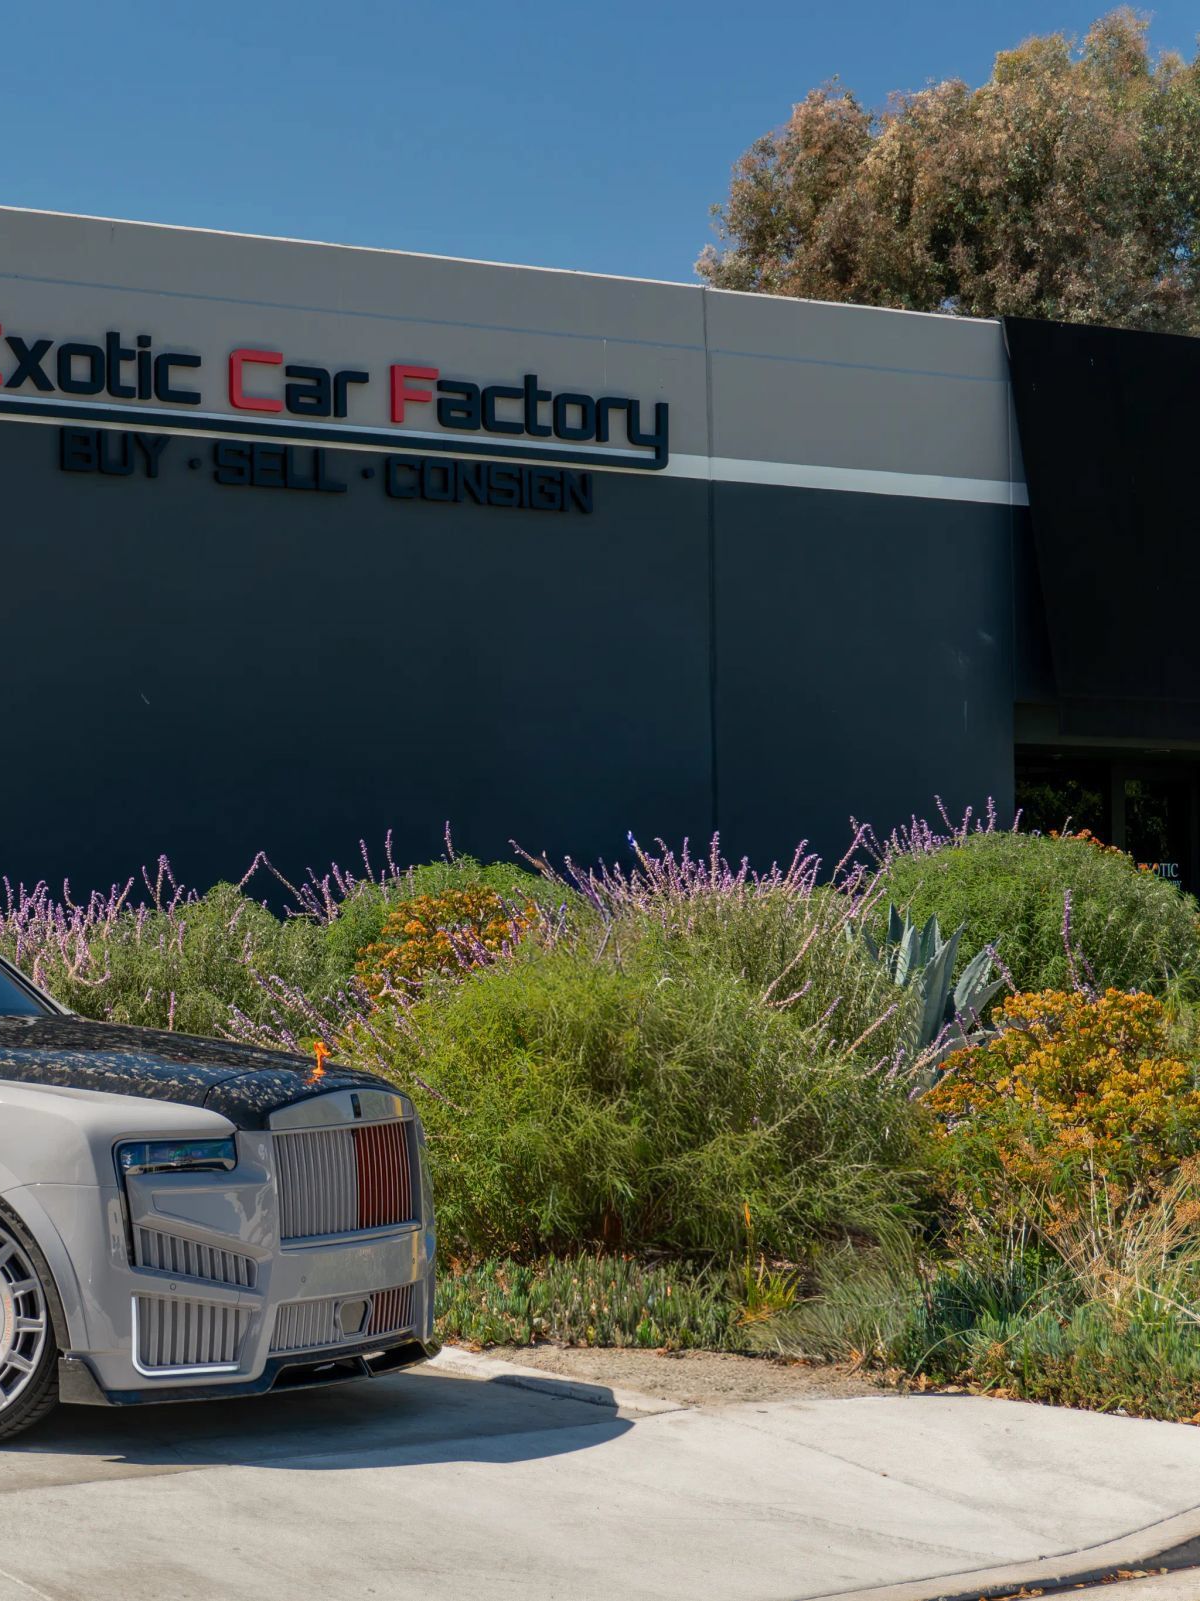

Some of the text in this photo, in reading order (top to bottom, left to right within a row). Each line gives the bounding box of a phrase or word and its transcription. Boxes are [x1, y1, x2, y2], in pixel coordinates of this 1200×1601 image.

[229, 349, 369, 418] Car
[390, 364, 669, 470] Factory
[60, 426, 594, 514] BUY SELL CONSIGN
